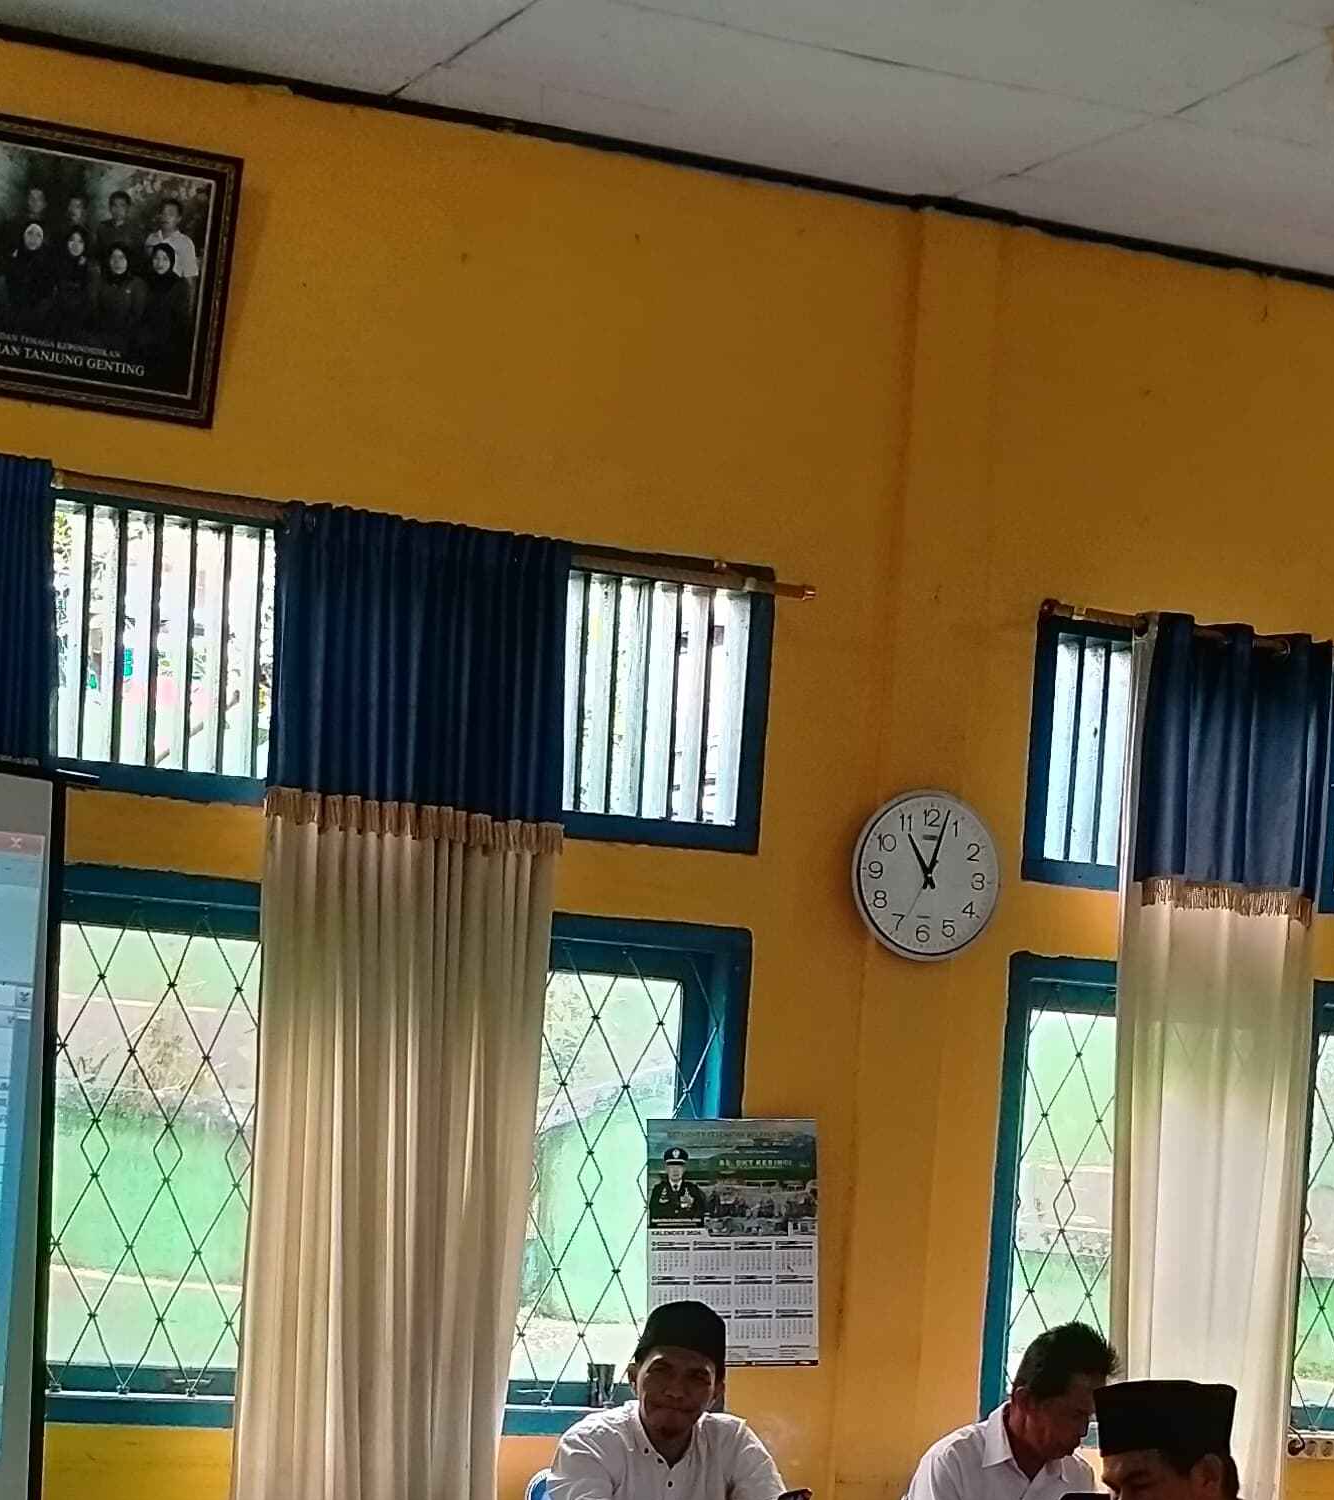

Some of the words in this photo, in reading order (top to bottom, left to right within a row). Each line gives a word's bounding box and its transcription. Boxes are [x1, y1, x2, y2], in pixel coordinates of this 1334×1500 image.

[24, 347, 83, 367] TANJUNG
[86, 358, 145, 377] GENTING
[900, 813, 912, 832] 11
[924, 808, 941, 828] 12
[952, 820, 959, 838] 1
[877, 833, 897, 852] 10
[967, 843, 980, 862] 2
[868, 861, 883, 879] 9
[971, 873, 986, 891] 3
[873, 890, 887, 908] 8
[962, 901, 975, 919] 4
[892, 913, 905, 931] 7
[942, 919, 956, 938] 5
[916, 924, 931, 943] 6
